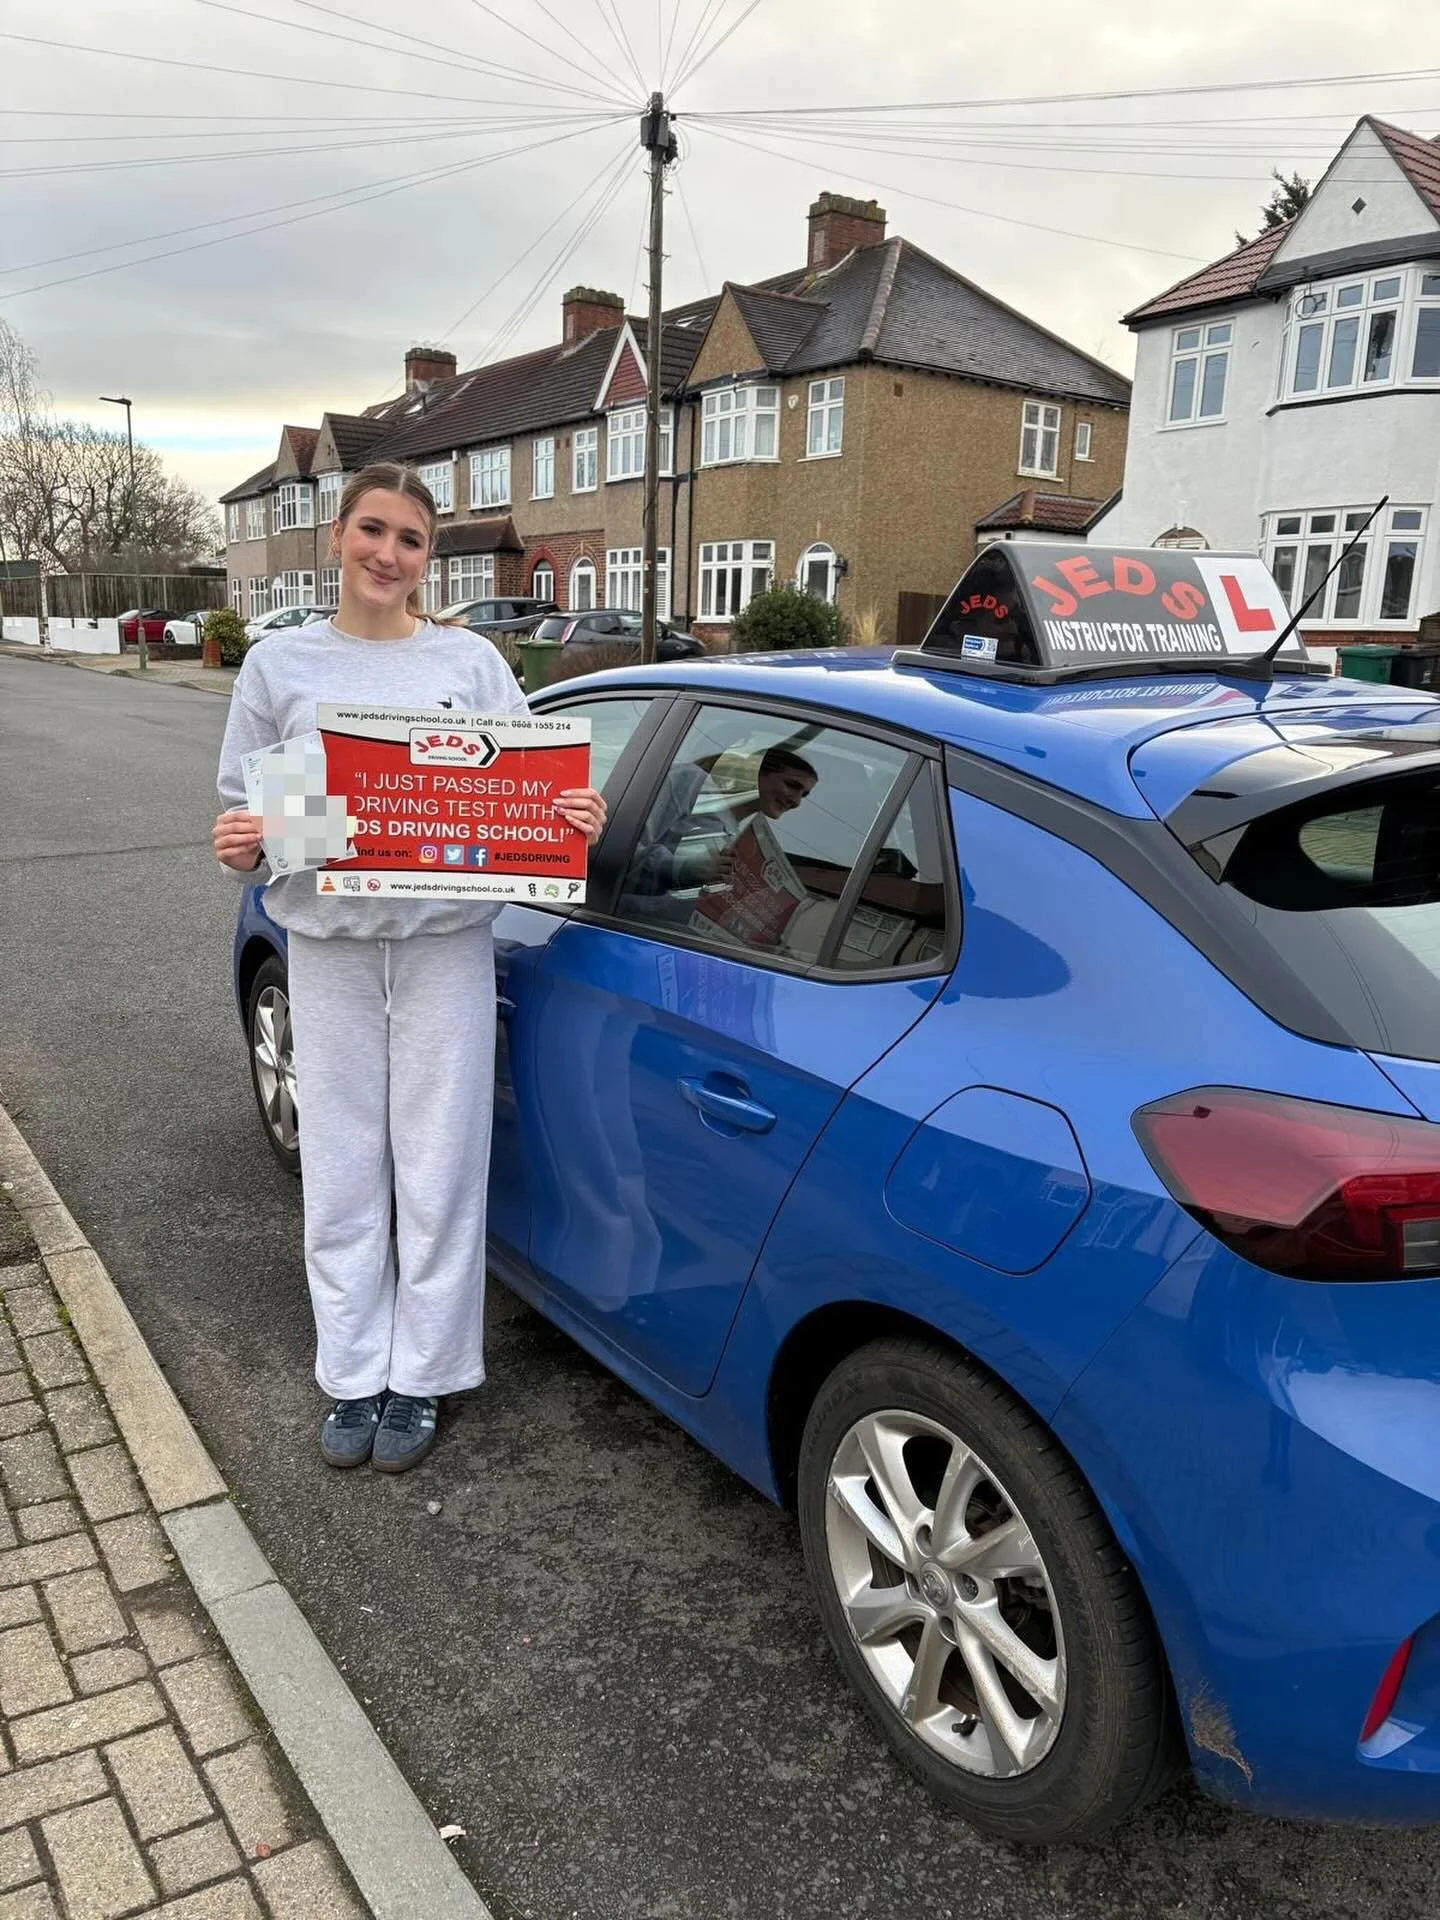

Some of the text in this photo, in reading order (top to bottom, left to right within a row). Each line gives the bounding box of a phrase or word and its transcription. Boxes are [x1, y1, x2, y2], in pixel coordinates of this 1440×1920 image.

[1032, 555, 1206, 621] JEDS
[959, 594, 1009, 620] JEDS
[1219, 575, 1277, 632] L
[1044, 620, 1222, 653] INSTRUCTOR TRAINING
[336, 711, 467, 725] www.jedsdrivingschool.co.uk
[476, 718, 493, 727] Call
[556, 723, 571, 731] 214
[414, 735, 480, 755] JEDS
[374, 773, 427, 791] JUST
[433, 776, 515, 796] PASSED
[522, 780, 552, 797] MY
[354, 795, 555, 820] DRIVING TEST WITH
[355, 819, 574, 842] DS DRIVING SCHOOL!”
[357, 846, 375, 857] ind
[378, 849, 391, 857] us
[394, 848, 412, 858] on:
[494, 852, 570, 864] #JEDSDRIVING
[390, 882, 515, 895] www.jedsdrivingschool.co.uk
